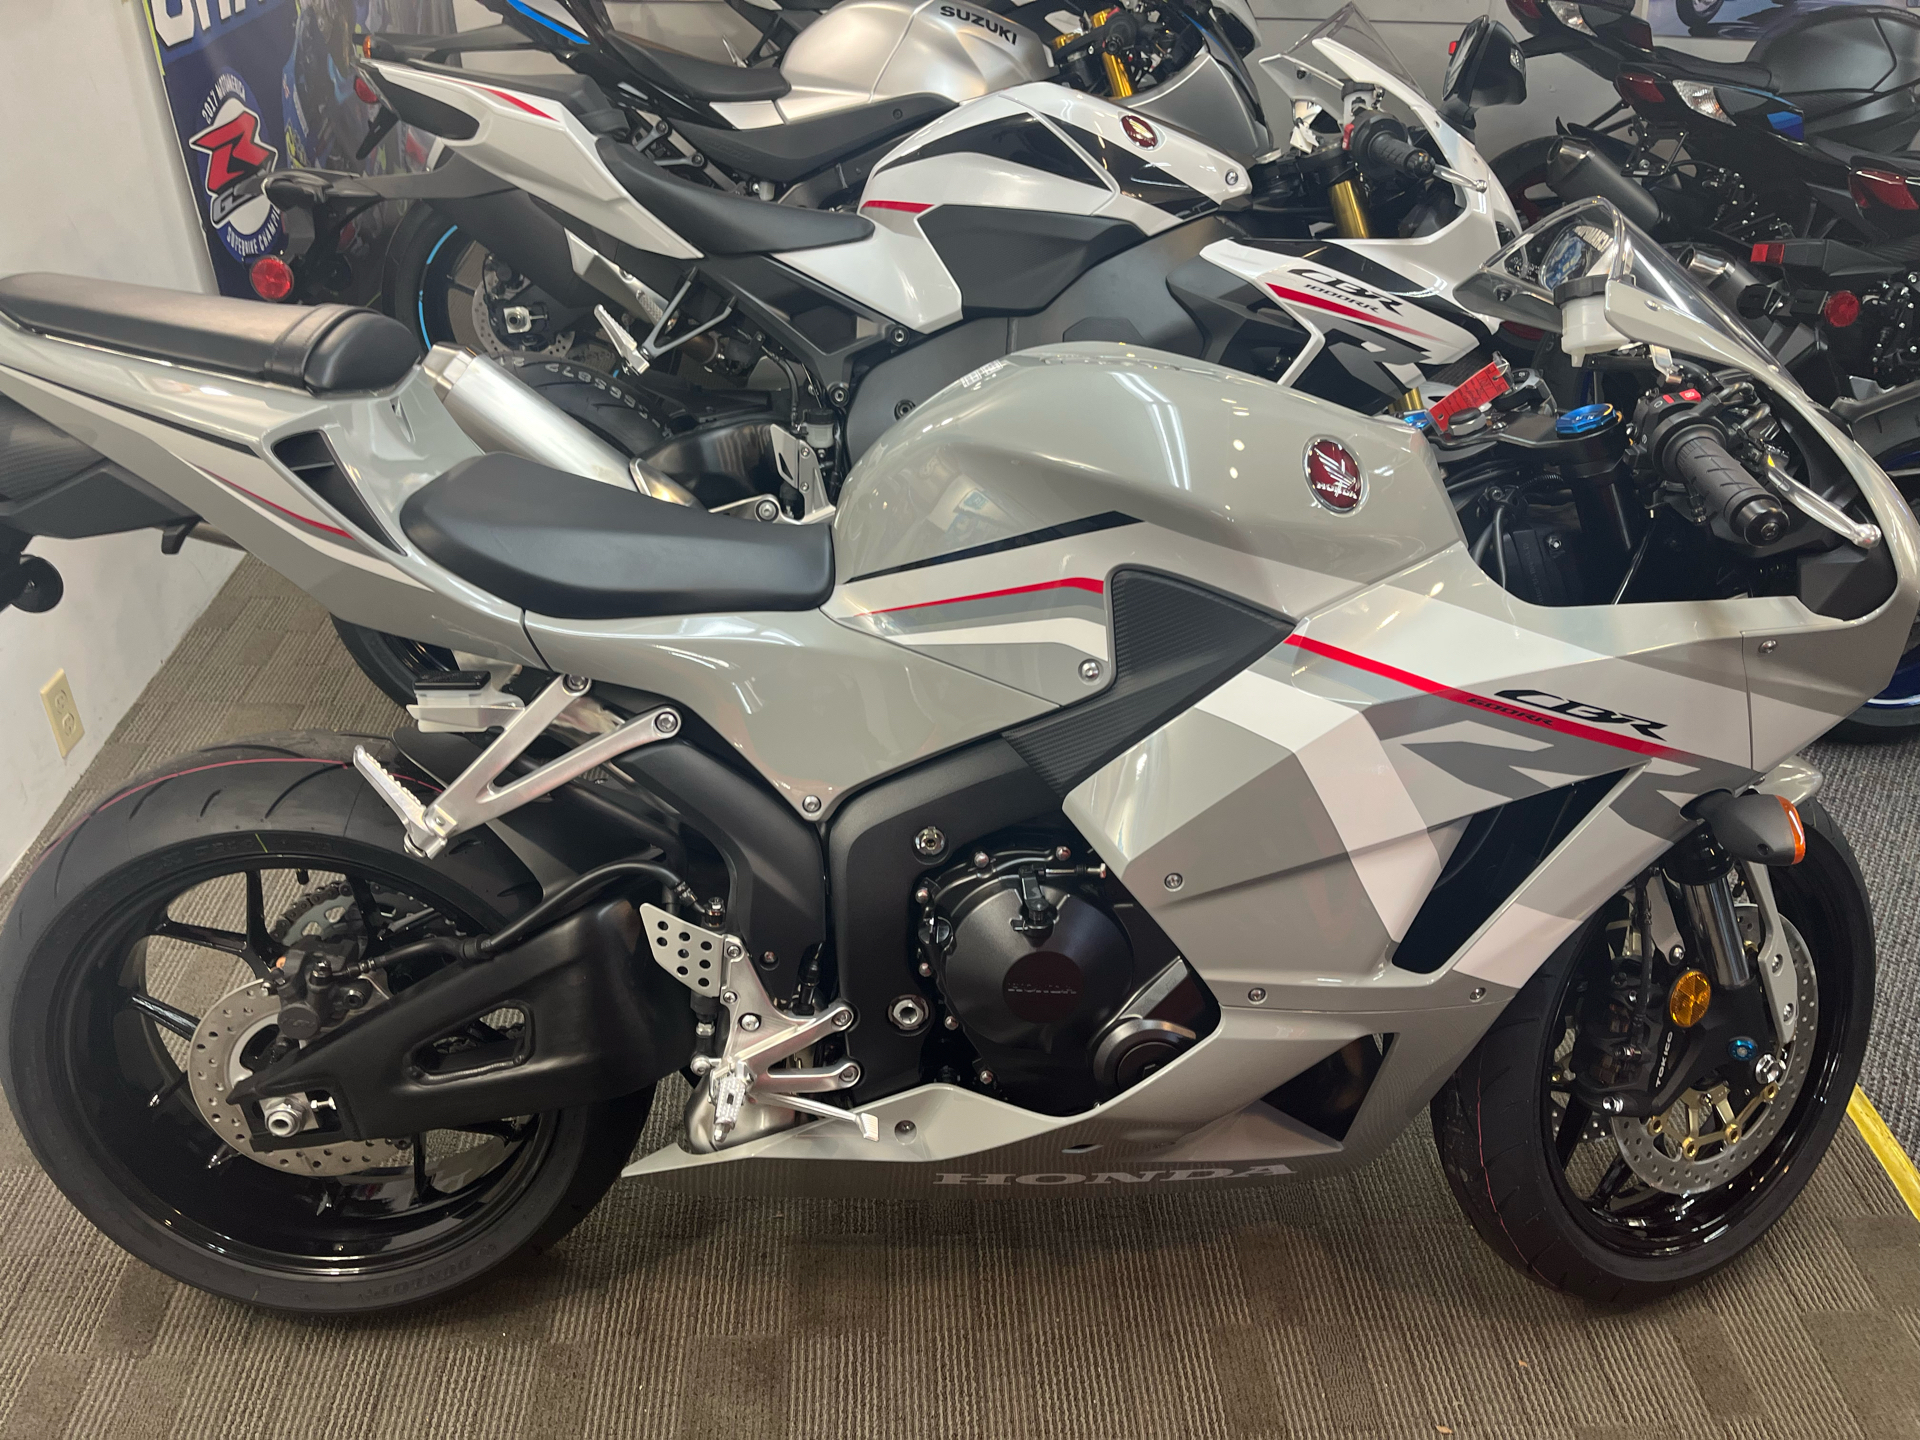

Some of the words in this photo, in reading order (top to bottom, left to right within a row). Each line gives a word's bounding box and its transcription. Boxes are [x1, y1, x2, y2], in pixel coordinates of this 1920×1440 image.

[940, 6, 1017, 46] SUZUKI
[202, 90, 219, 125] 2017
[226, 226, 258, 256] SUPERBIKE
[1287, 268, 1404, 317] CBR
[1303, 284, 1380, 313] 1000RR
[1467, 697, 1554, 726] 600RR
[1494, 689, 1669, 742] CBR
[1655, 1031, 1673, 1088] TOKICO
[933, 1163, 1298, 1186] HONDA
